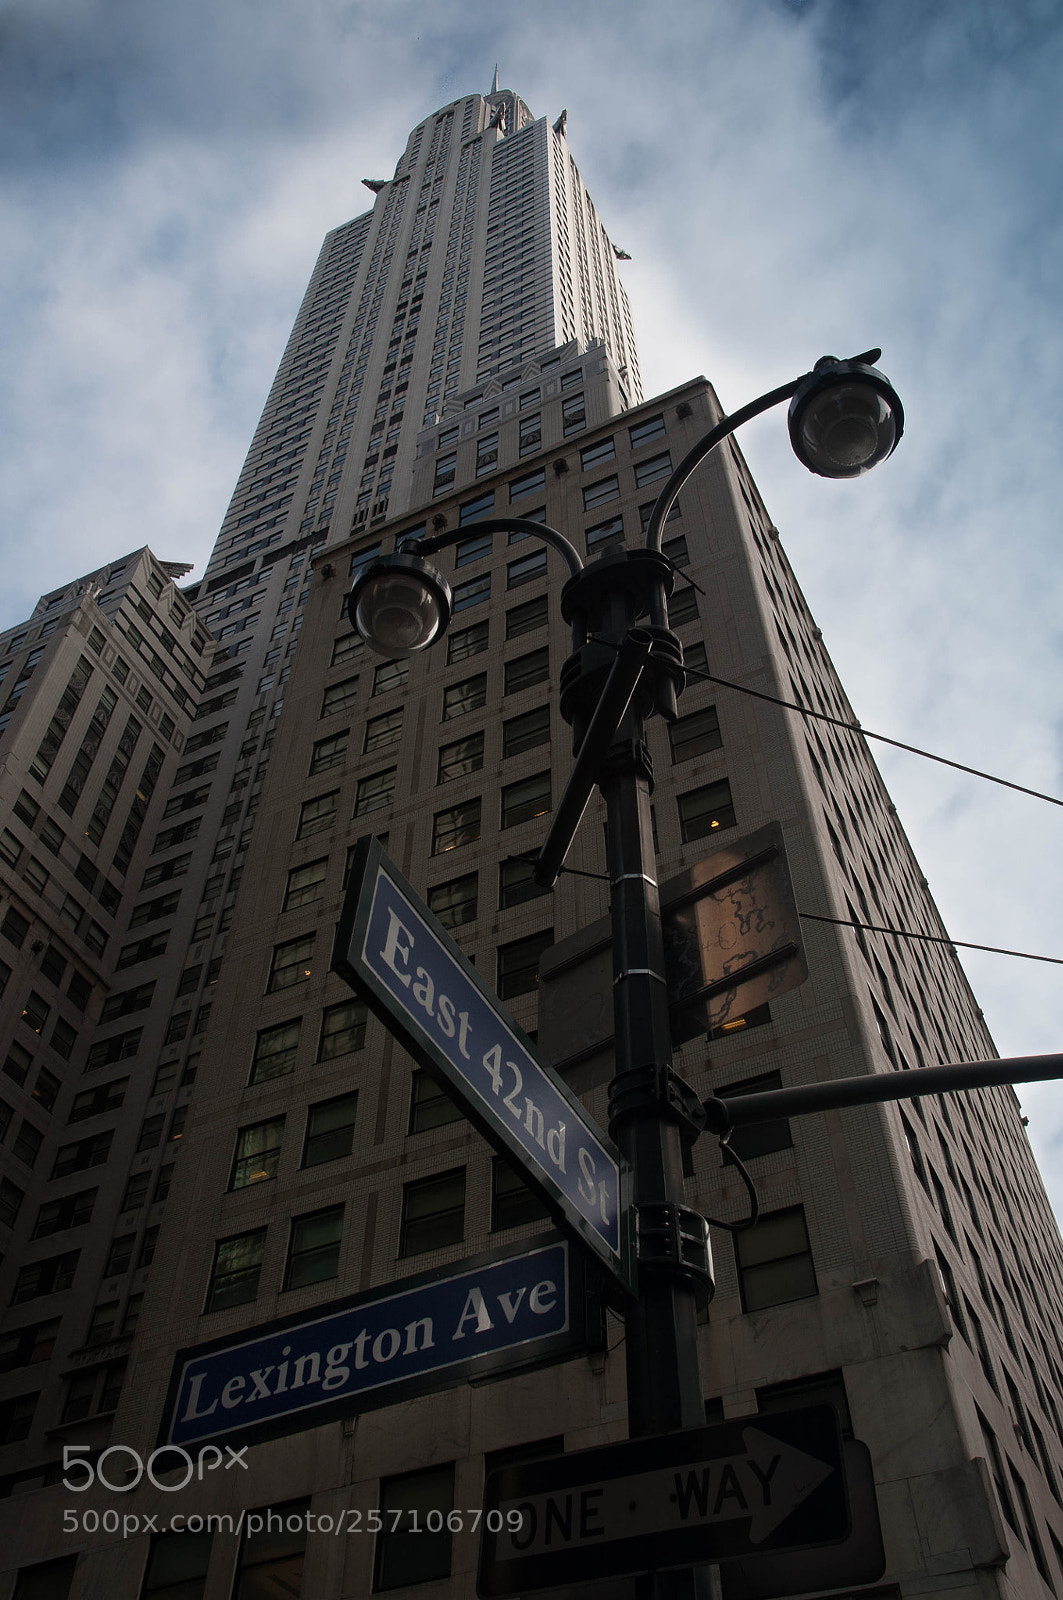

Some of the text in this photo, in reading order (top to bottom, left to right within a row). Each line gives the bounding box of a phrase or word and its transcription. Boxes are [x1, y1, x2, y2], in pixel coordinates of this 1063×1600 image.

[380, 906, 610, 1226] East 42nd St
[180, 1279, 558, 1423] Lexington Ave
[509, 1454, 781, 1550] ONE WAY
